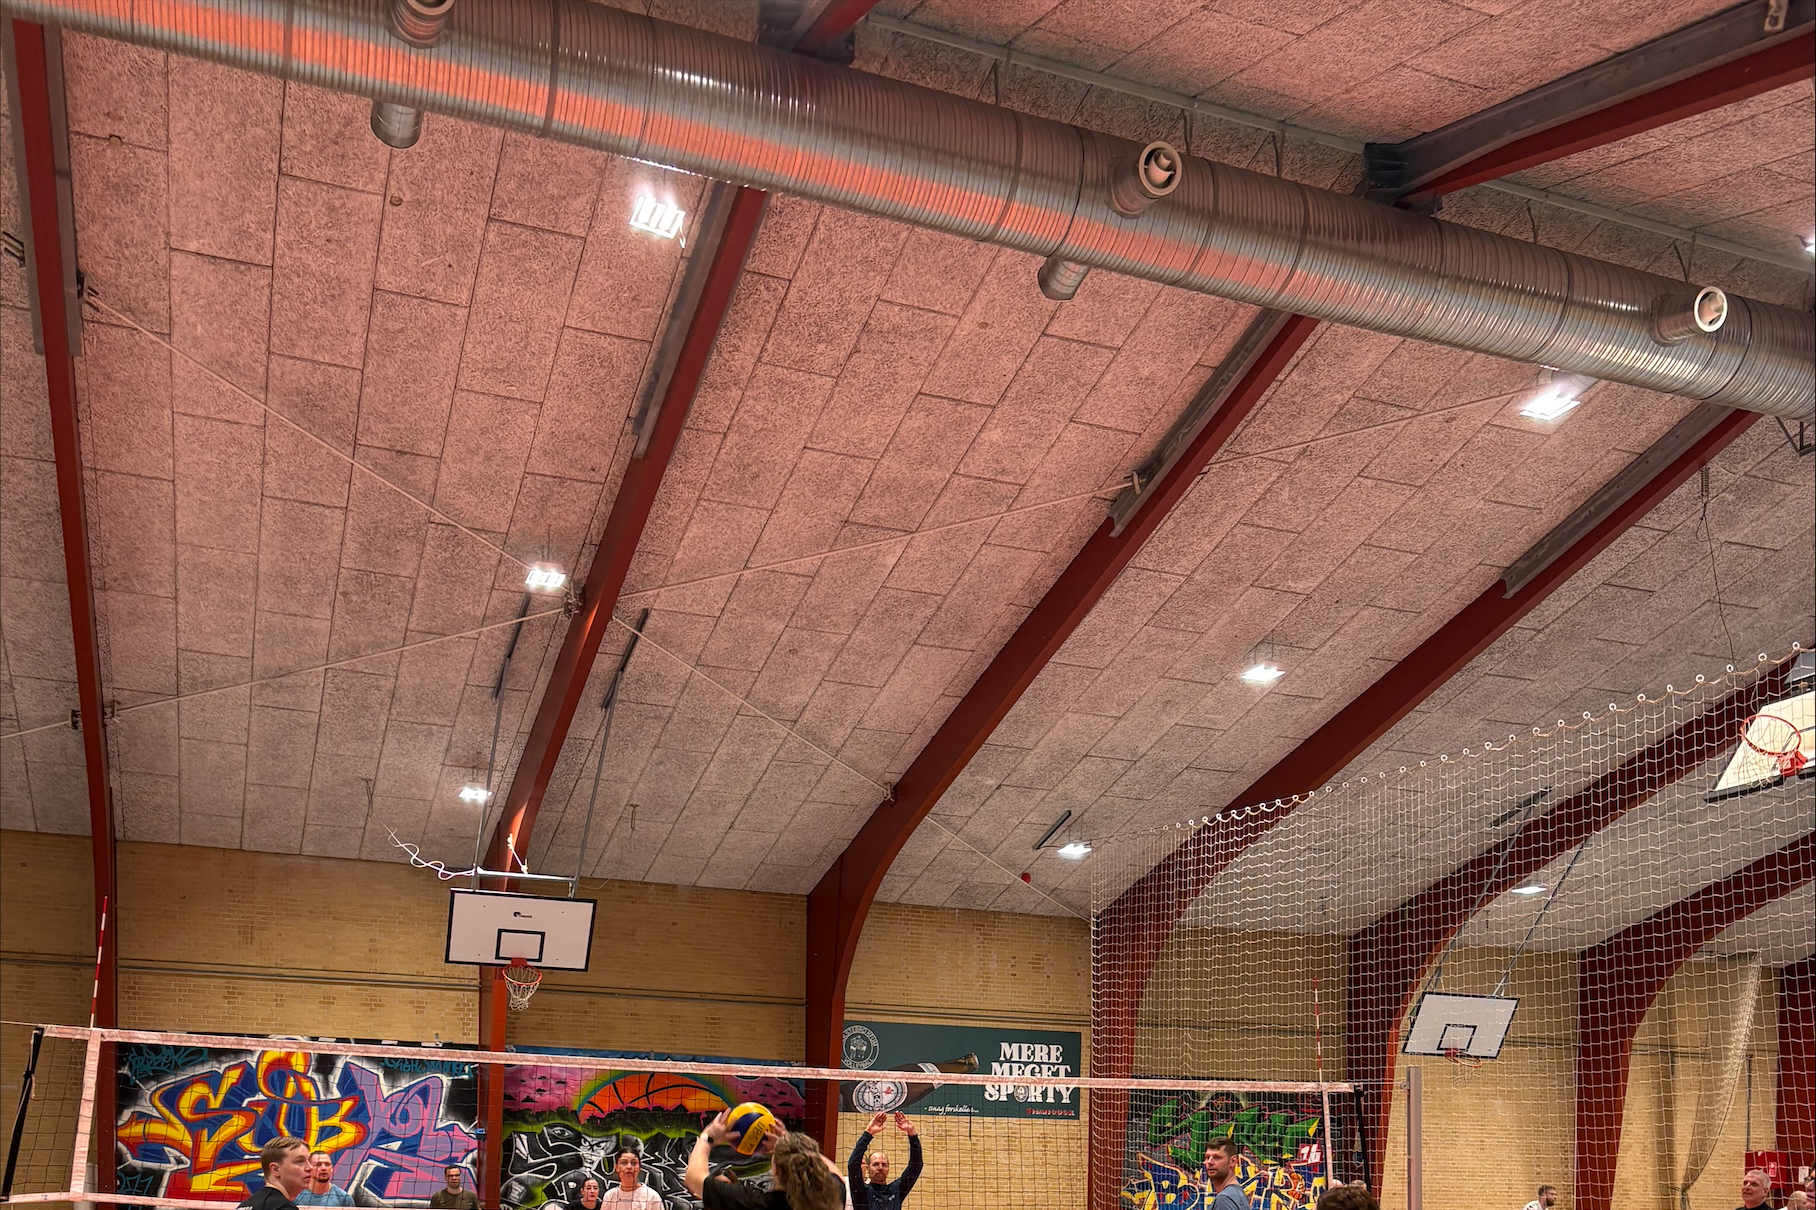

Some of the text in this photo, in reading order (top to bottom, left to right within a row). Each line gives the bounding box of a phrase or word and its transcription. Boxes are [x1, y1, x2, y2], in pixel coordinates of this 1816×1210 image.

[999, 1042, 1064, 1063] MERE
[991, 1062, 1071, 1078] MEGET
[984, 1083, 1076, 1104] SPORTY
